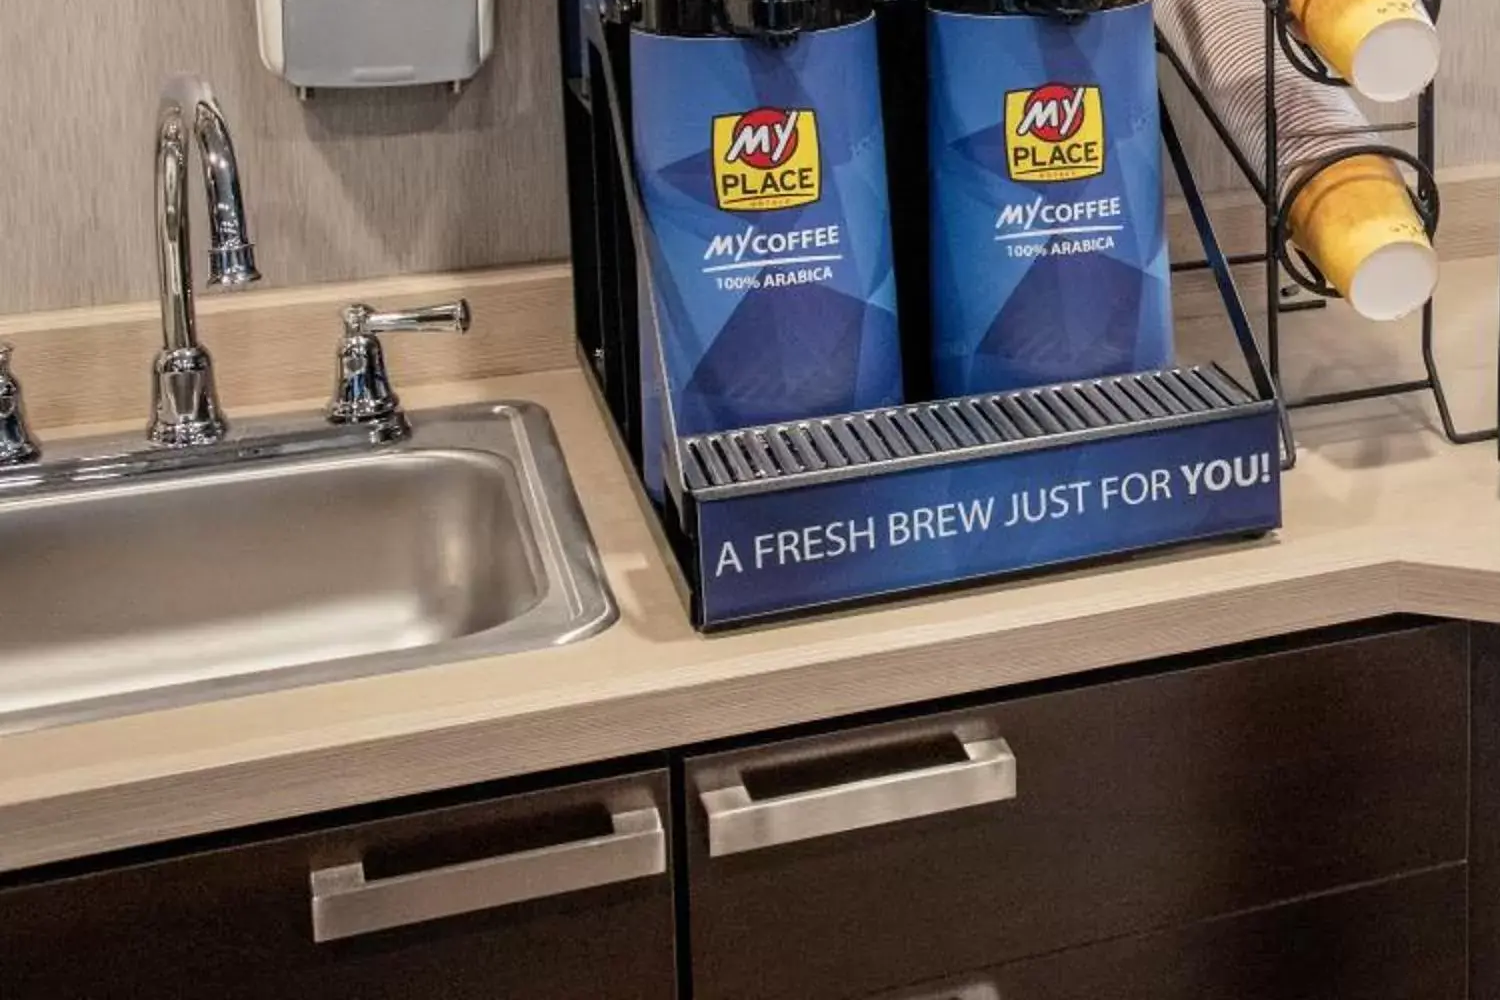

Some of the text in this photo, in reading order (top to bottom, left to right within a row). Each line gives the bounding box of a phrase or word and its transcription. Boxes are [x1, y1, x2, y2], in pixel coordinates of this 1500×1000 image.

[1013, 142, 1099, 167] PLACE
[721, 167, 815, 196] PLACE
[1007, 236, 1115, 258] 100% ARABICA
[716, 266, 833, 291] 100% ARABICA
[715, 452, 1272, 577] A FRESH BREW JUST FOR YOU!
